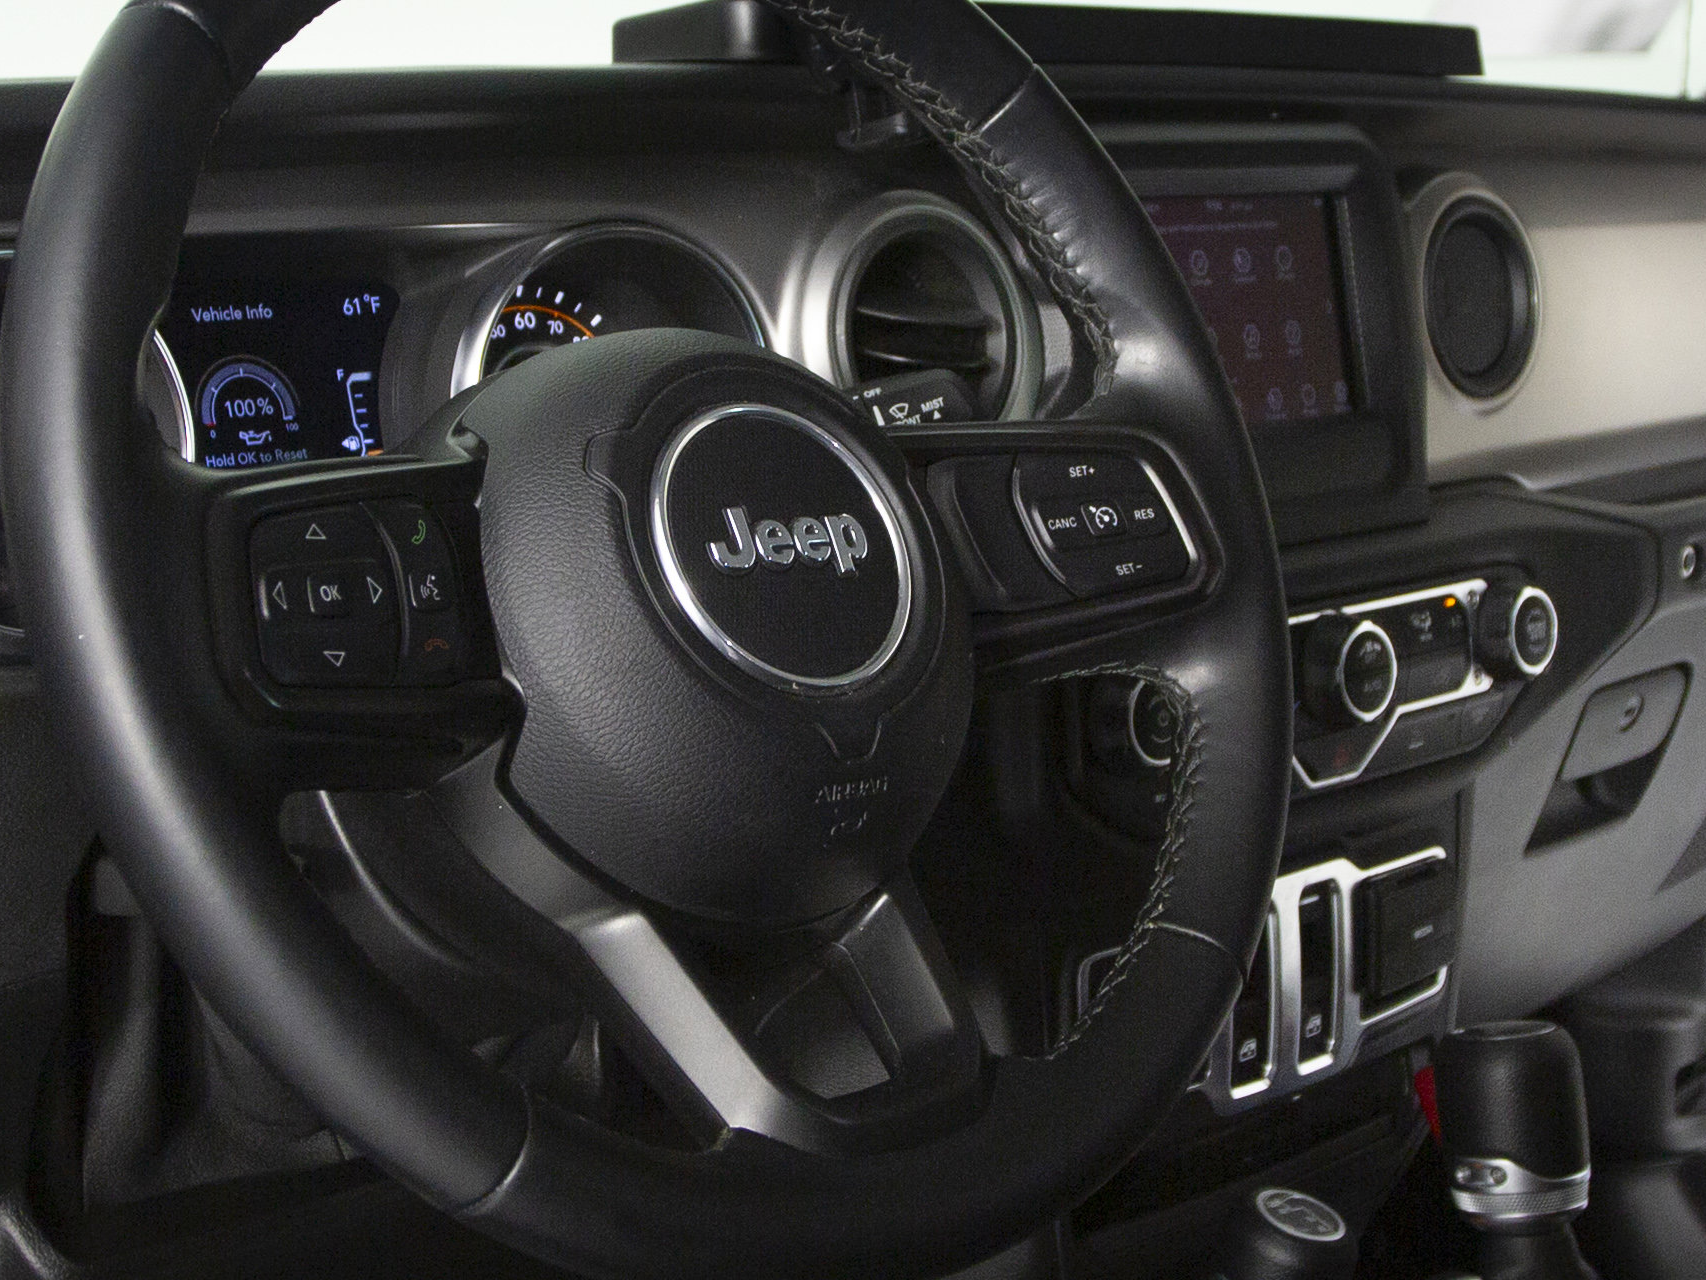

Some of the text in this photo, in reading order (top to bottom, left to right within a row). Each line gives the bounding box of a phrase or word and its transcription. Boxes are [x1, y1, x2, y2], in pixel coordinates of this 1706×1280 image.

[191, 303, 273, 322] Vehicle Info
[514, 311, 536, 330] 60
[547, 320, 564, 335] 70
[336, 369, 344, 381] F
[863, 387, 882, 398] OFF
[921, 397, 944, 413] MIST
[210, 430, 216, 439] 0
[285, 423, 299, 431] 100
[205, 448, 308, 468] Hold OK to Reset
[1069, 465, 1095, 478] SET+
[1133, 508, 1155, 521] RES
[1047, 517, 1077, 532] CANC
[705, 506, 869, 578] Jeep
[319, 583, 341, 605] OK
